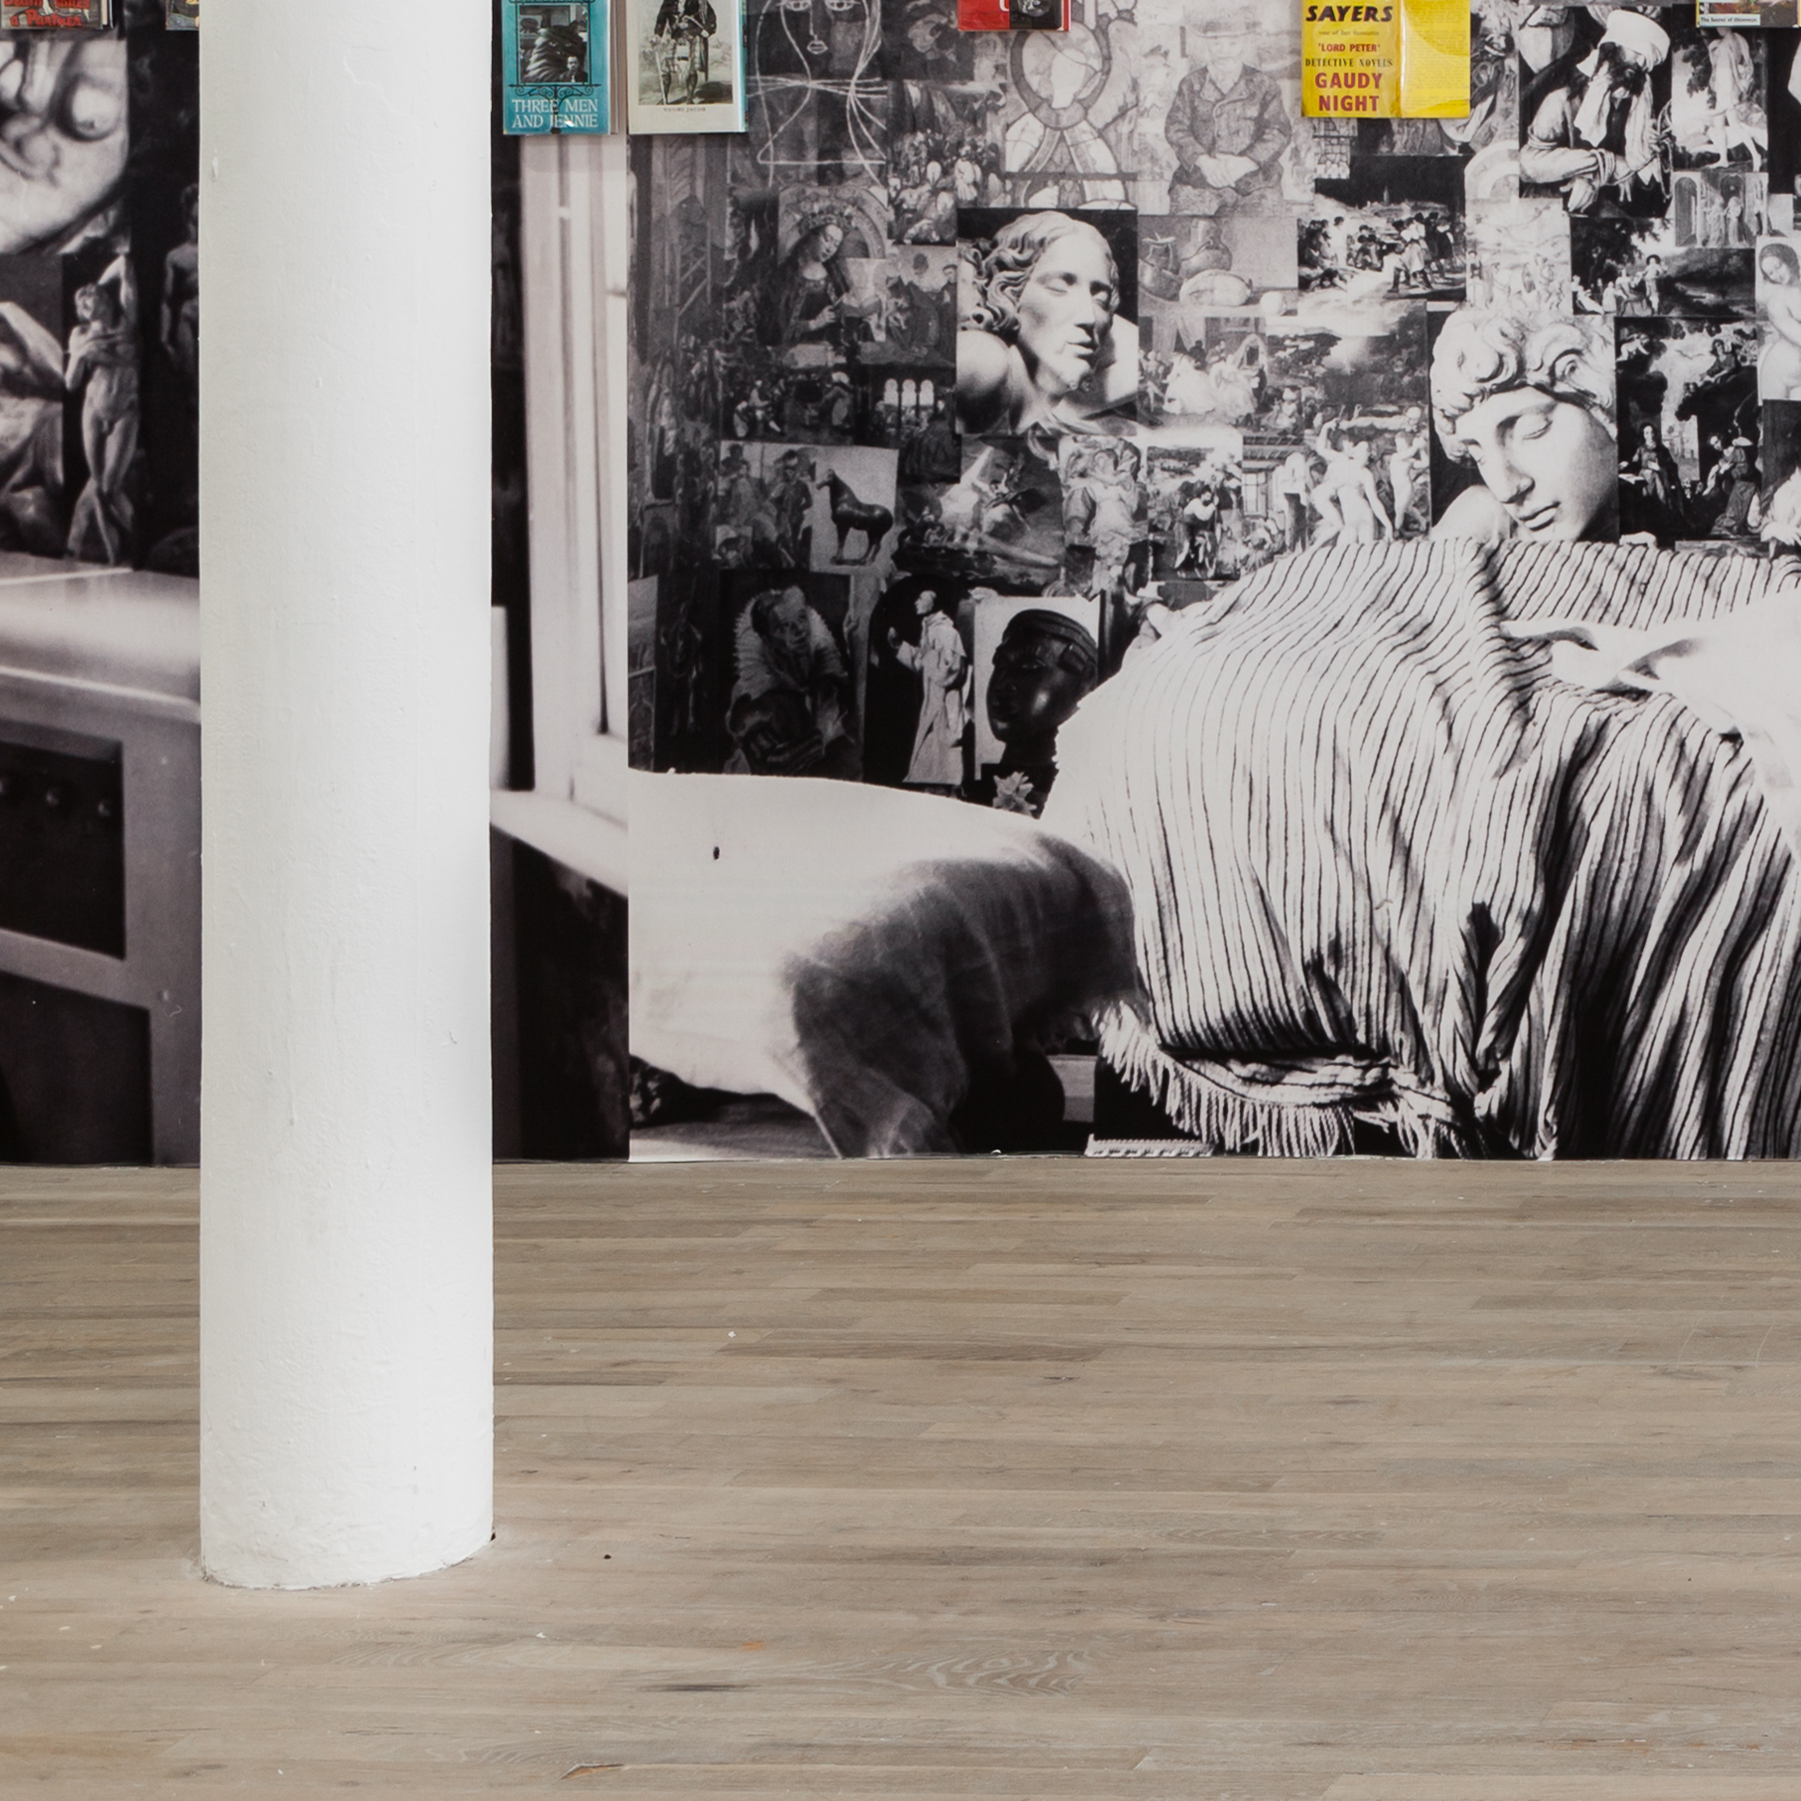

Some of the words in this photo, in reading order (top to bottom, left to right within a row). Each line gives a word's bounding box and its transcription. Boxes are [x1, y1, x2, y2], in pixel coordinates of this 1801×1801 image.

[1305, 5, 1393, 22] SAYERS
[1305, 58, 1354, 67] DETECTIVE
[1359, 58, 1393, 67] NOVELS
[1315, 72, 1383, 89] GAUDY
[512, 99, 559, 113] THREE
[565, 99, 598, 112] MEN
[1319, 95, 1380, 112] NIGHT
[512, 114, 544, 128] AND
[547, 114, 598, 131] JENNIE
